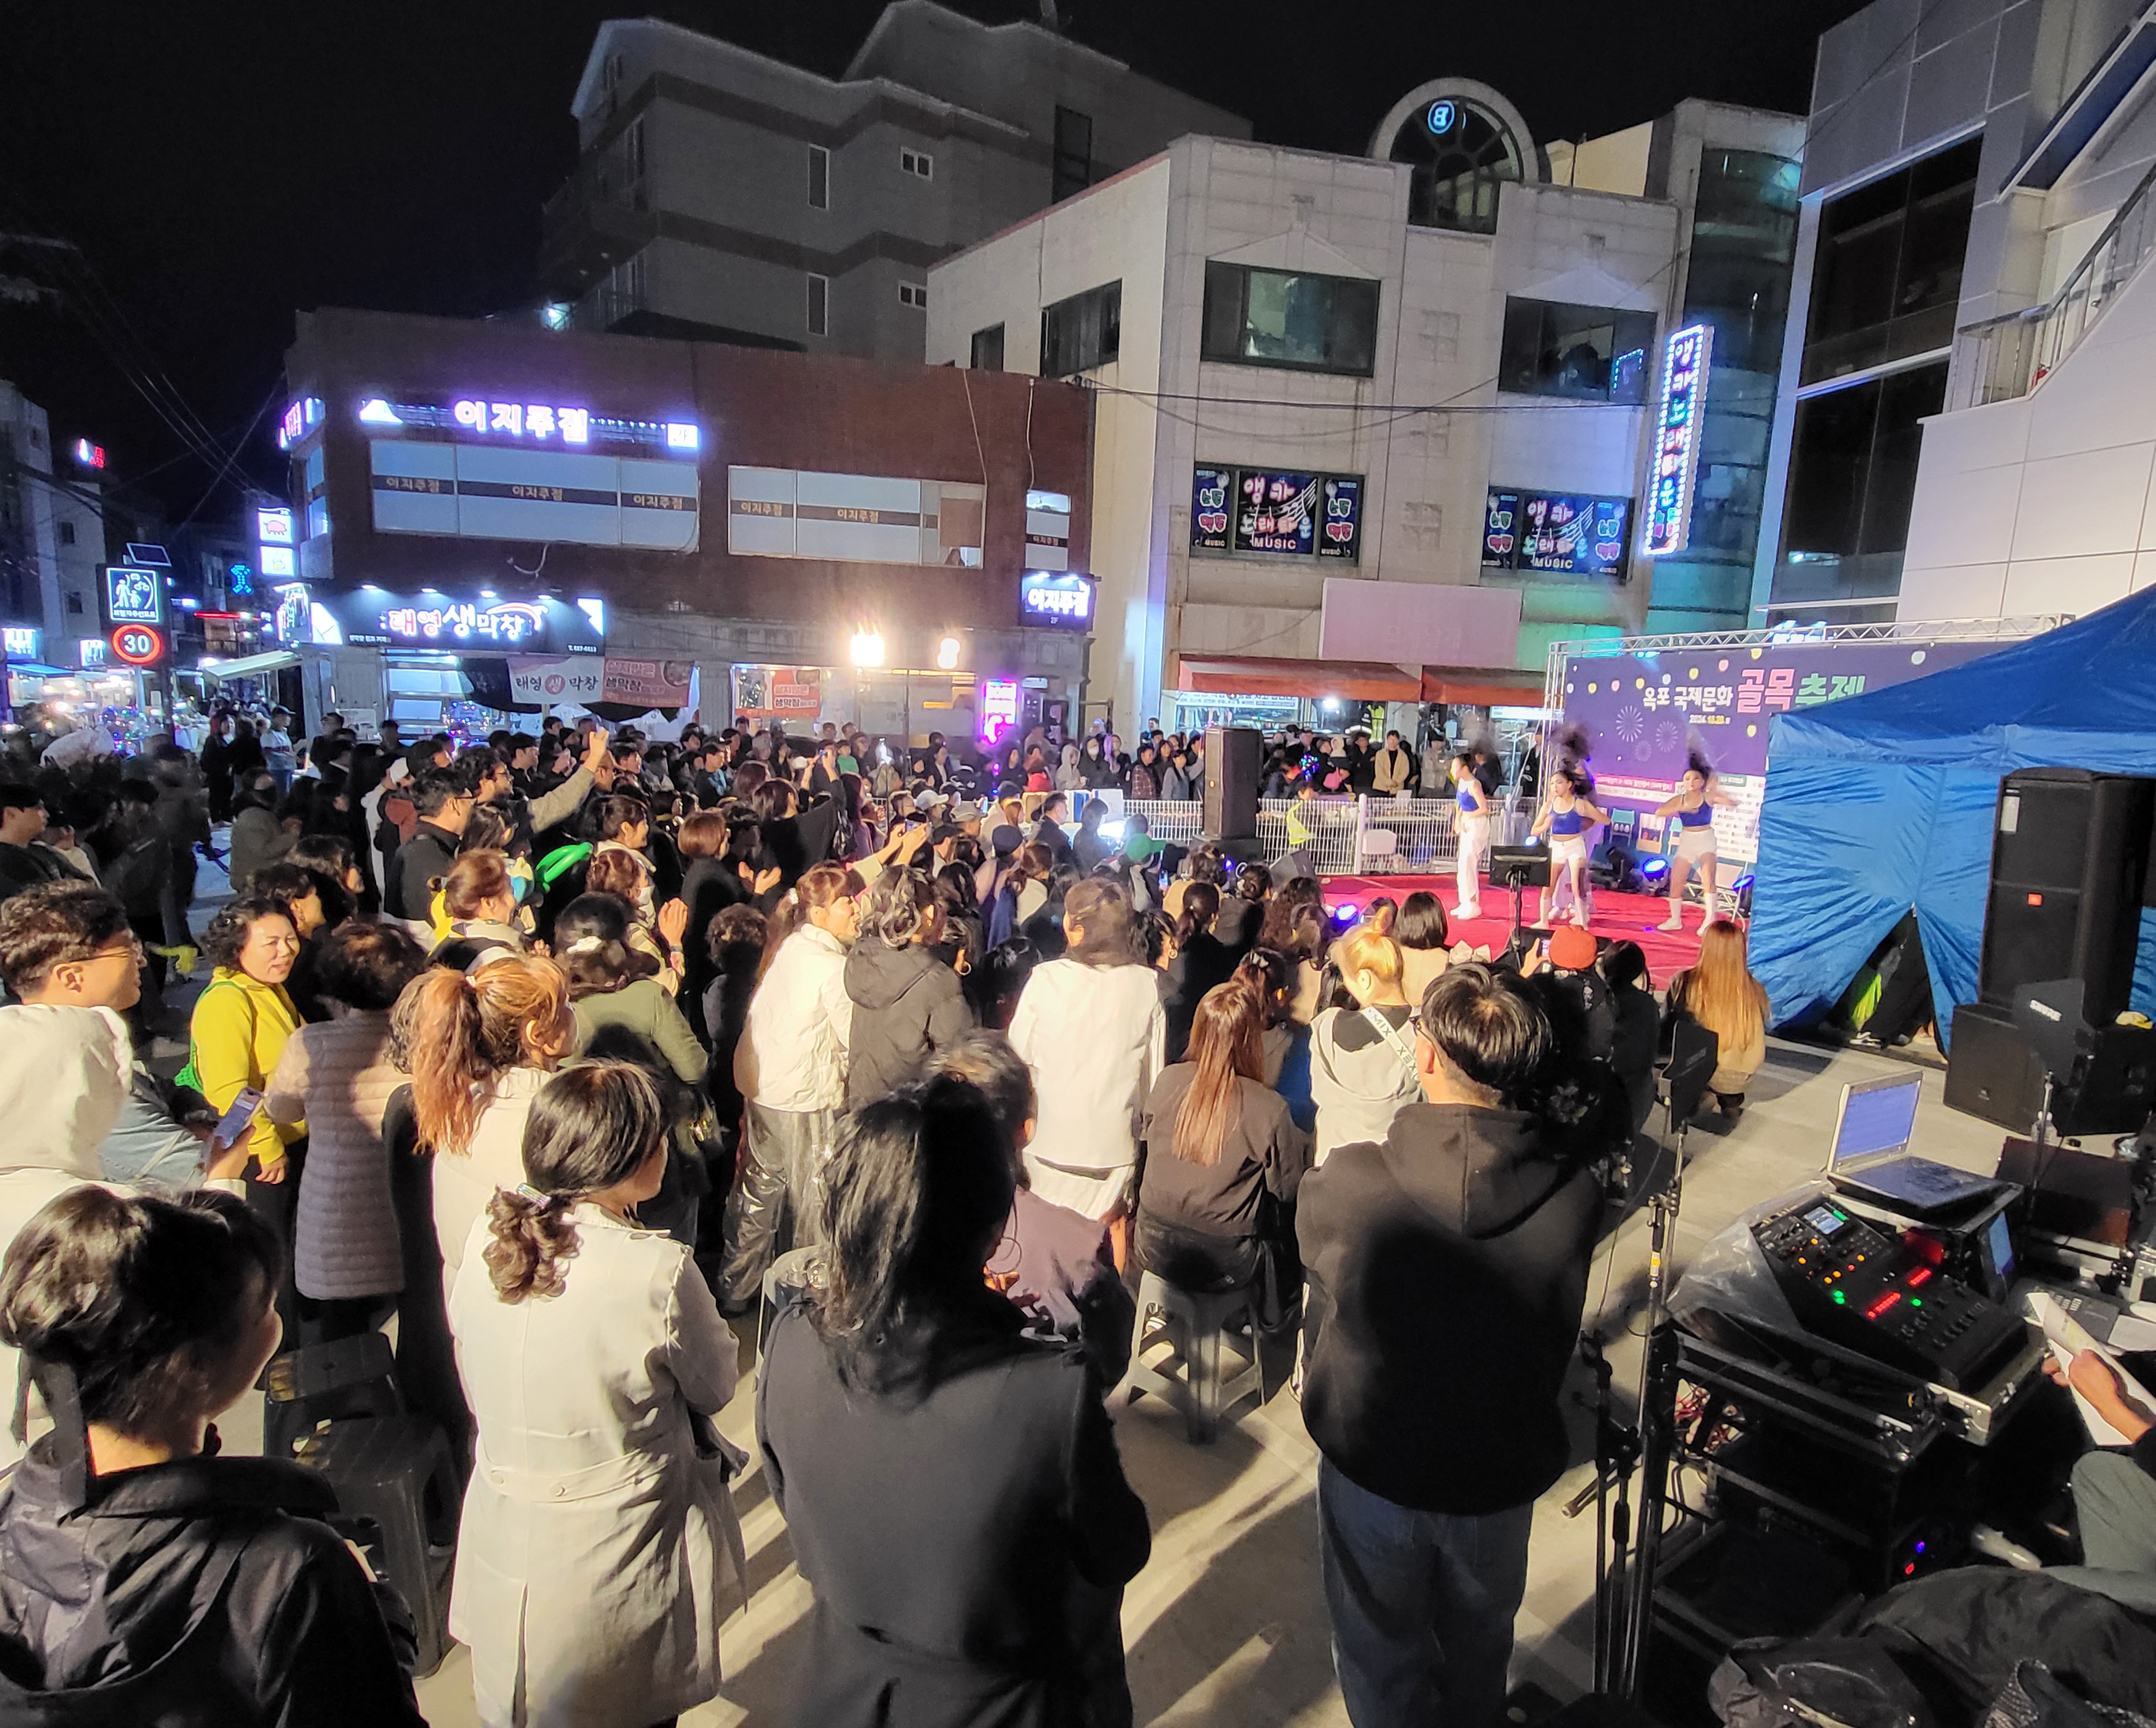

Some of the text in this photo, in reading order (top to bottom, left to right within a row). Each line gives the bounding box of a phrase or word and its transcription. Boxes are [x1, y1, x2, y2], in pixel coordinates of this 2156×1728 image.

[455, 400, 589, 443] 이지주점
[386, 477, 439, 493] 이지주점
[512, 485, 563, 502] 이지주점
[633, 494, 682, 510] 이지주점
[741, 502, 782, 517] 이지주점
[837, 509, 879, 523] 이지주점
[1254, 537, 1296, 550] MUSIC
[1534, 558, 1573, 569] MUSIC
[1028, 588, 1088, 616] 이지주점
[124, 634, 150, 653] 30
[515, 676, 542, 691] 태영
[569, 676, 599, 691] 막창
[1643, 687, 1671, 711] 옥포
[1675, 685, 1733, 712] 국제문화
[1737, 669, 1795, 714] 골목
